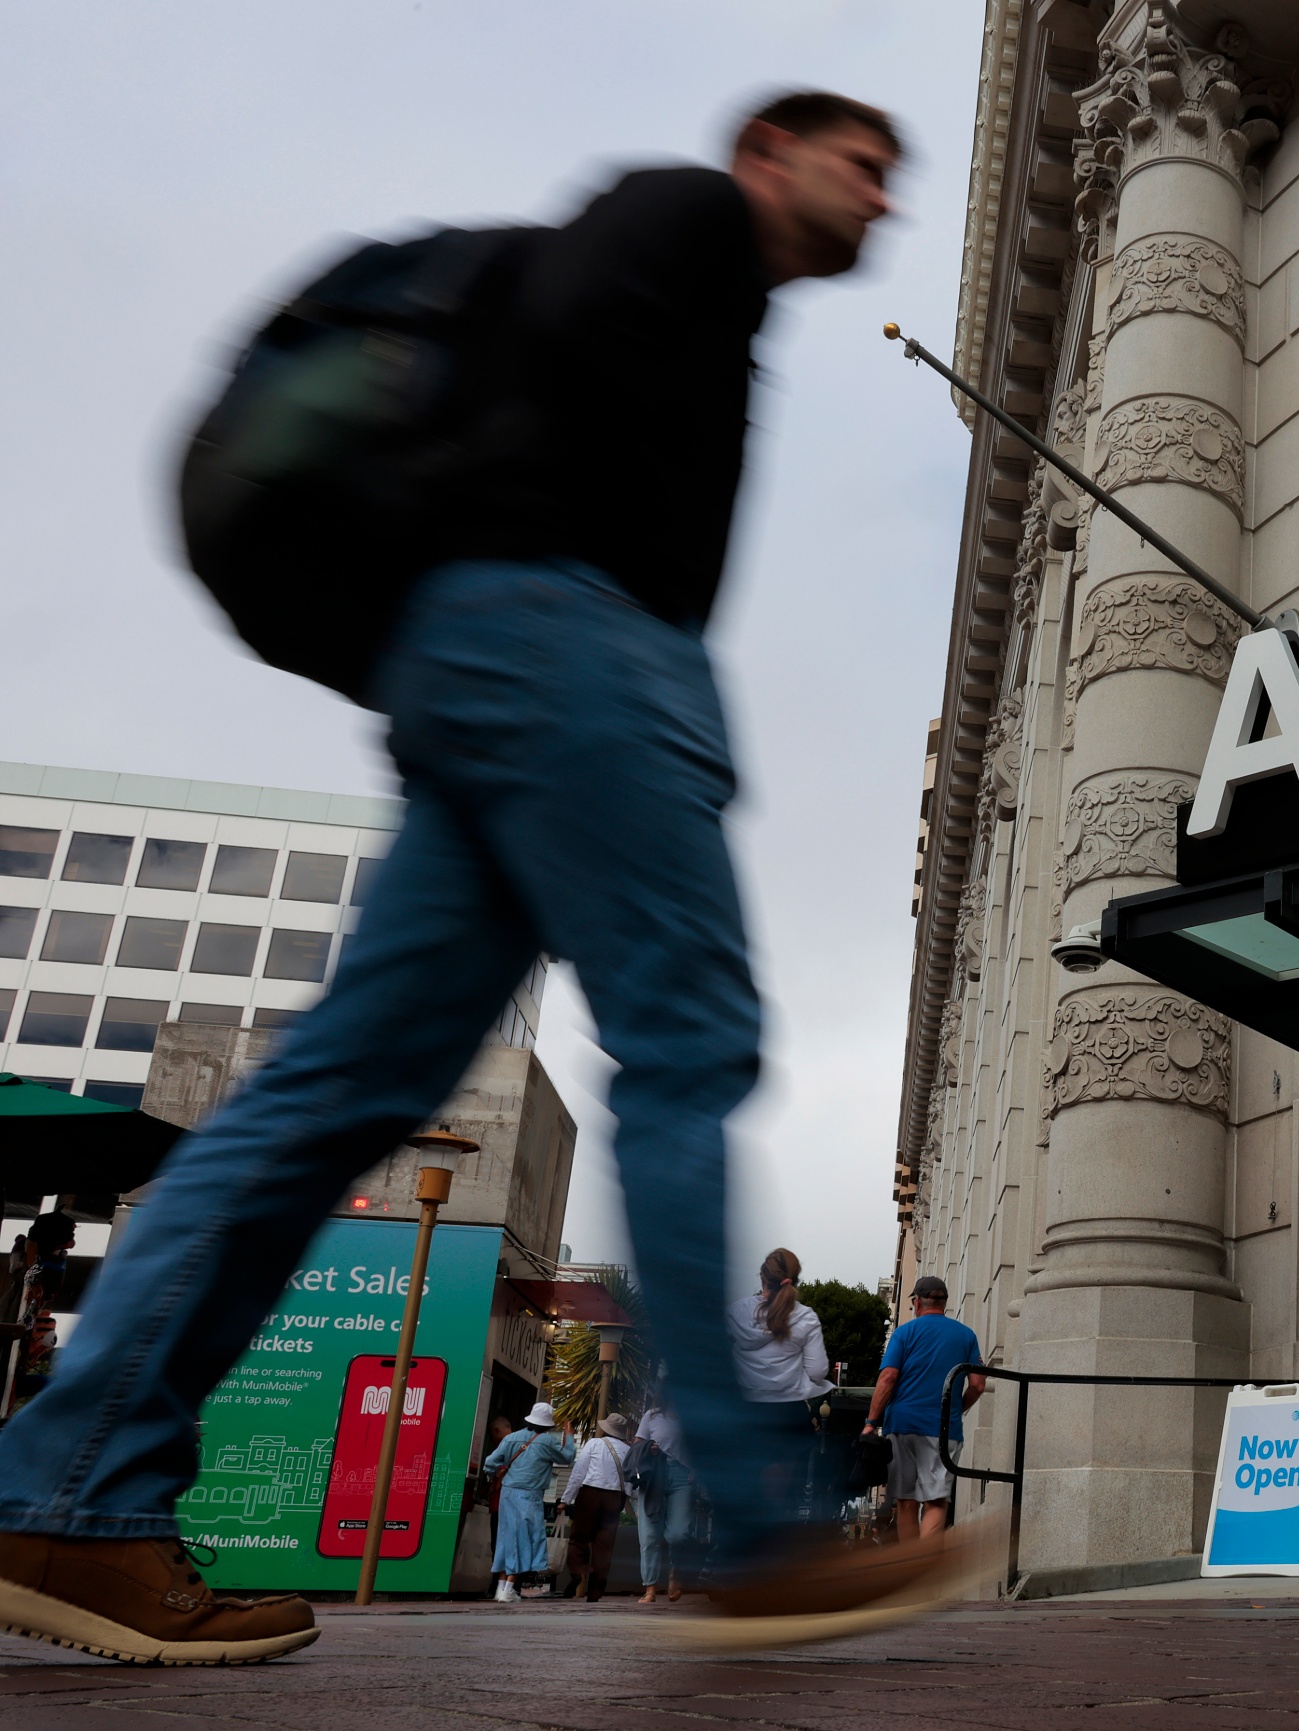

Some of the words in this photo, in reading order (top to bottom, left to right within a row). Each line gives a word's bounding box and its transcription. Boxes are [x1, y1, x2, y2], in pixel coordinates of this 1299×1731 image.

[284, 1266, 339, 1292] ket
[348, 1266, 430, 1297] Sales
[282, 1313, 330, 1331] your
[334, 1313, 385, 1332] cable
[249, 1335, 314, 1353] tickets
[501, 1298, 542, 1377] tickets
[241, 1366, 259, 1376] line
[261, 1367, 273, 1377] or
[275, 1368, 323, 1381] searching
[216, 1379, 239, 1389] With
[213, 1394, 233, 1405] just
[235, 1396, 242, 1404] a
[245, 1395, 262, 1406] tap
[264, 1396, 293, 1408] away.
[400, 1418, 421, 1426] obile
[1238, 1435, 1299, 1461] Now
[180, 1533, 299, 1551] m/MuniMobile
